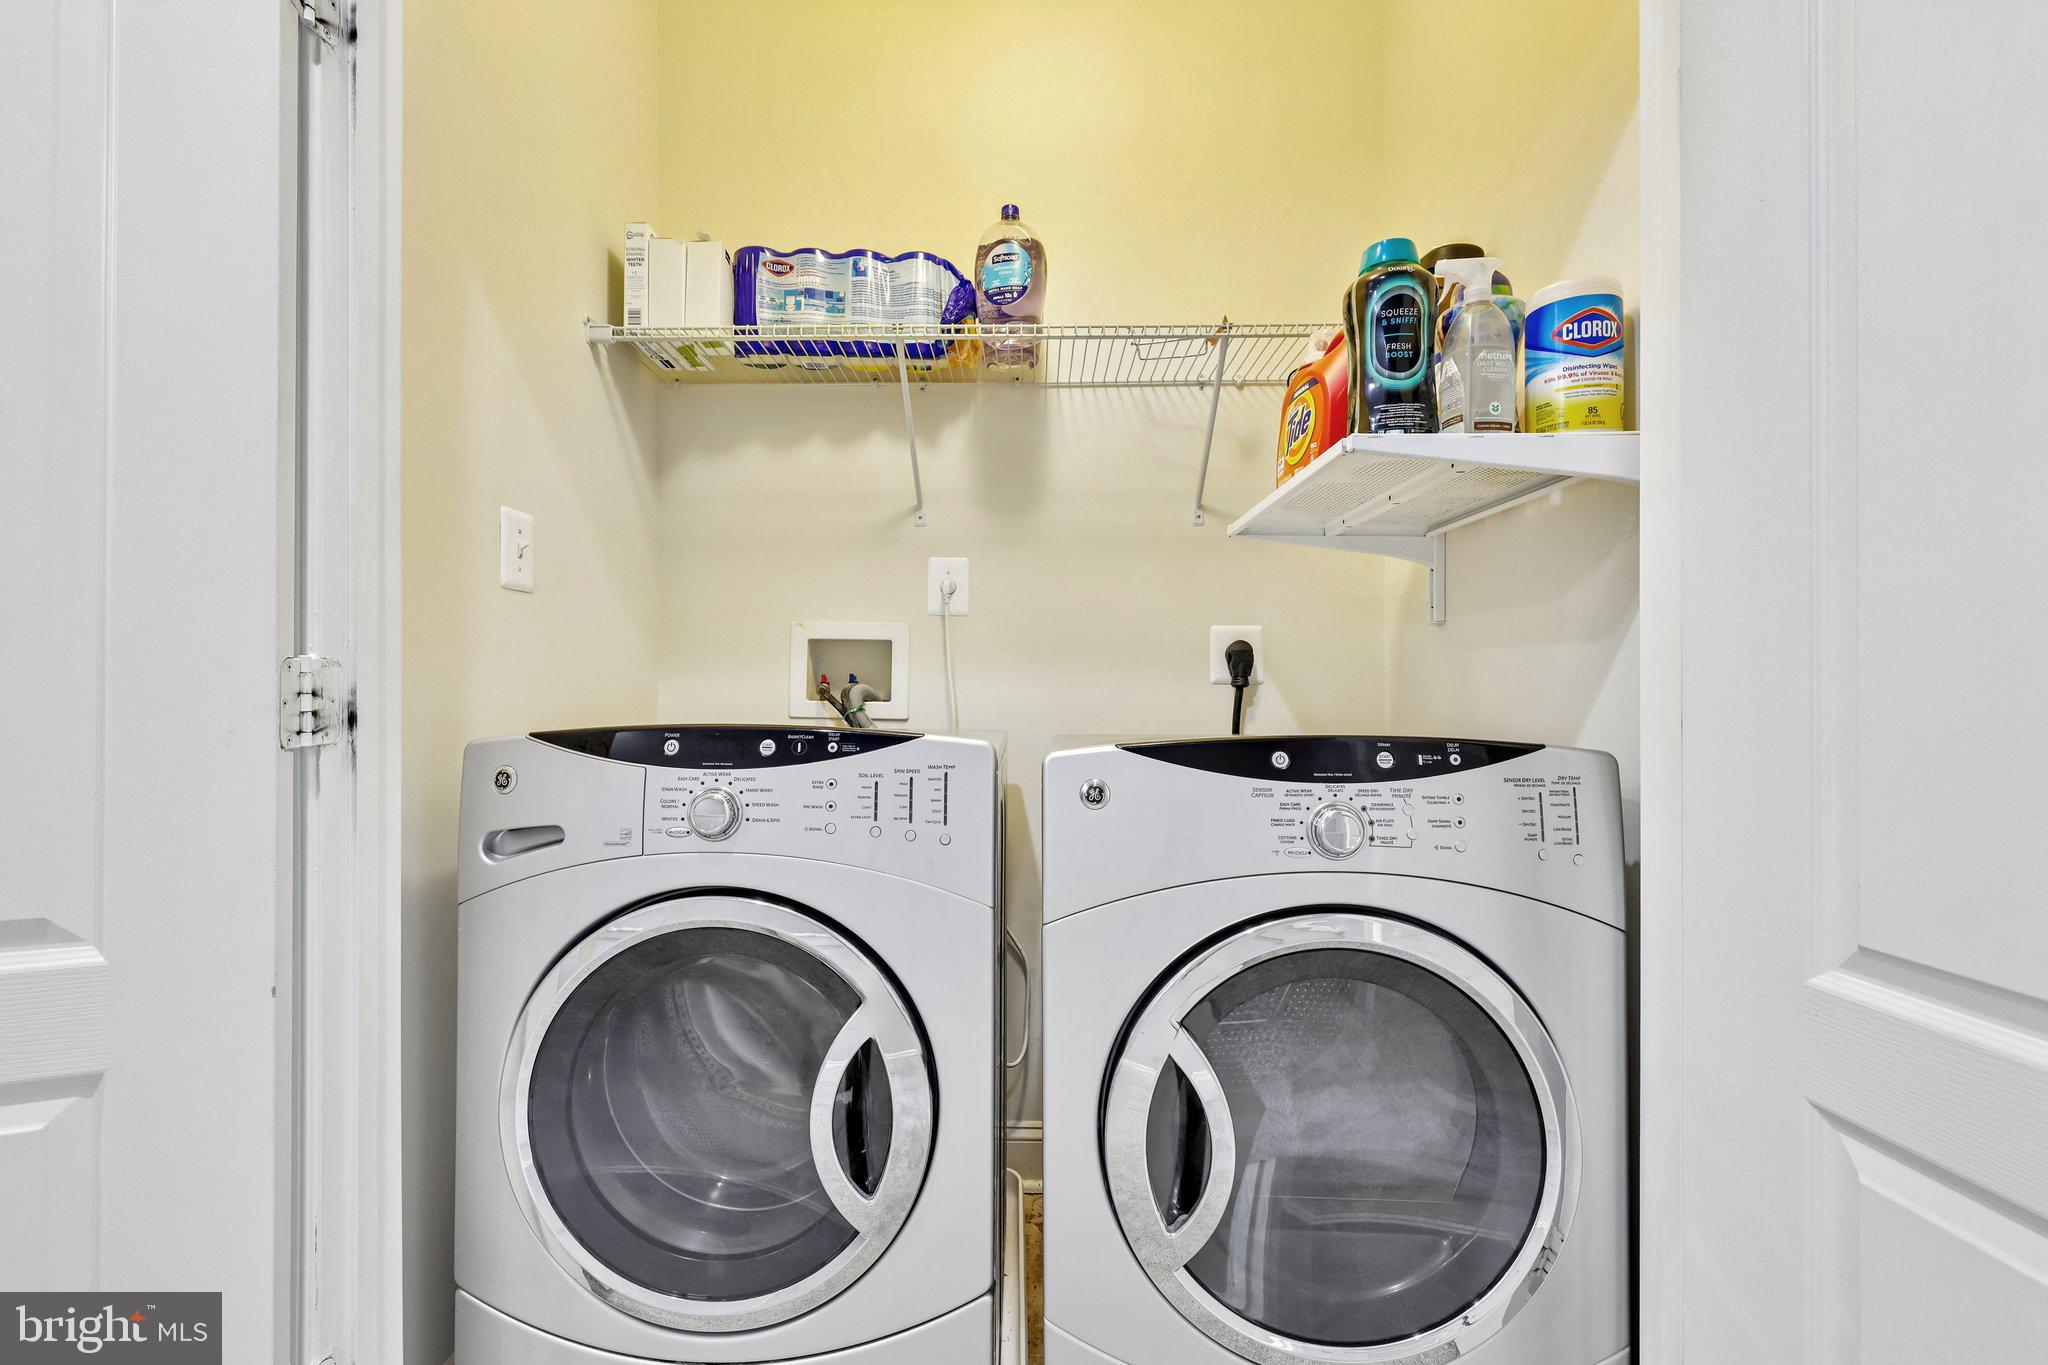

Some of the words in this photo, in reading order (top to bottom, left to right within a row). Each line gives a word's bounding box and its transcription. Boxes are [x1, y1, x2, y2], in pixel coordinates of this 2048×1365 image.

[766, 262, 791, 272] CLOROX
[1381, 308, 1418, 318] SQUEEZE
[1390, 317, 1417, 325] SNIFF!
[1562, 320, 1618, 341] CLOROX
[1562, 363, 1601, 372] Disinfecting
[1557, 372, 1579, 382] 99.9%
[1587, 406, 1598, 414] 85
[1286, 403, 1312, 458] Tide
